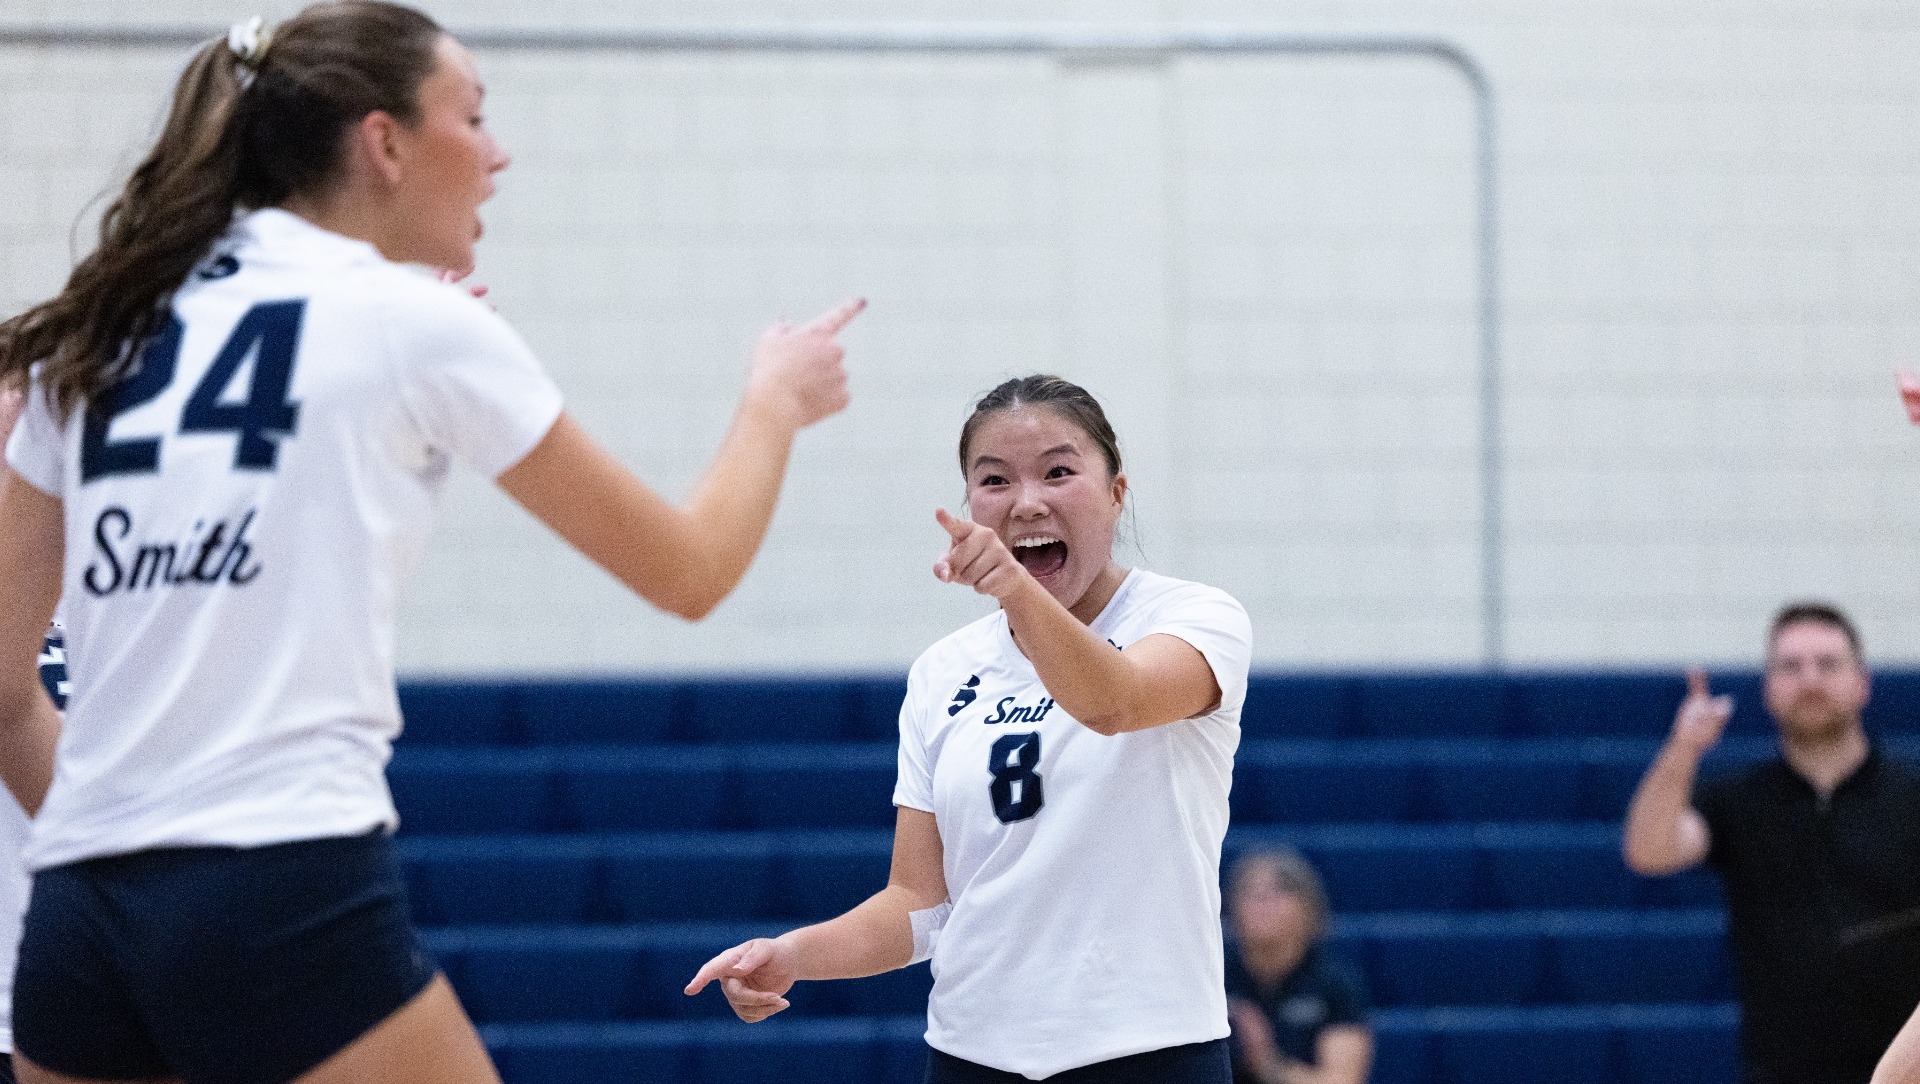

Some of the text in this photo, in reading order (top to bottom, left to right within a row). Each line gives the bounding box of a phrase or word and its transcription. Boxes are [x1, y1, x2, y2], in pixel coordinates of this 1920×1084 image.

[80, 297, 309, 485] 24
[84, 506, 261, 596] Smith
[983, 696, 1055, 725] Smit
[988, 730, 1045, 825] 8
